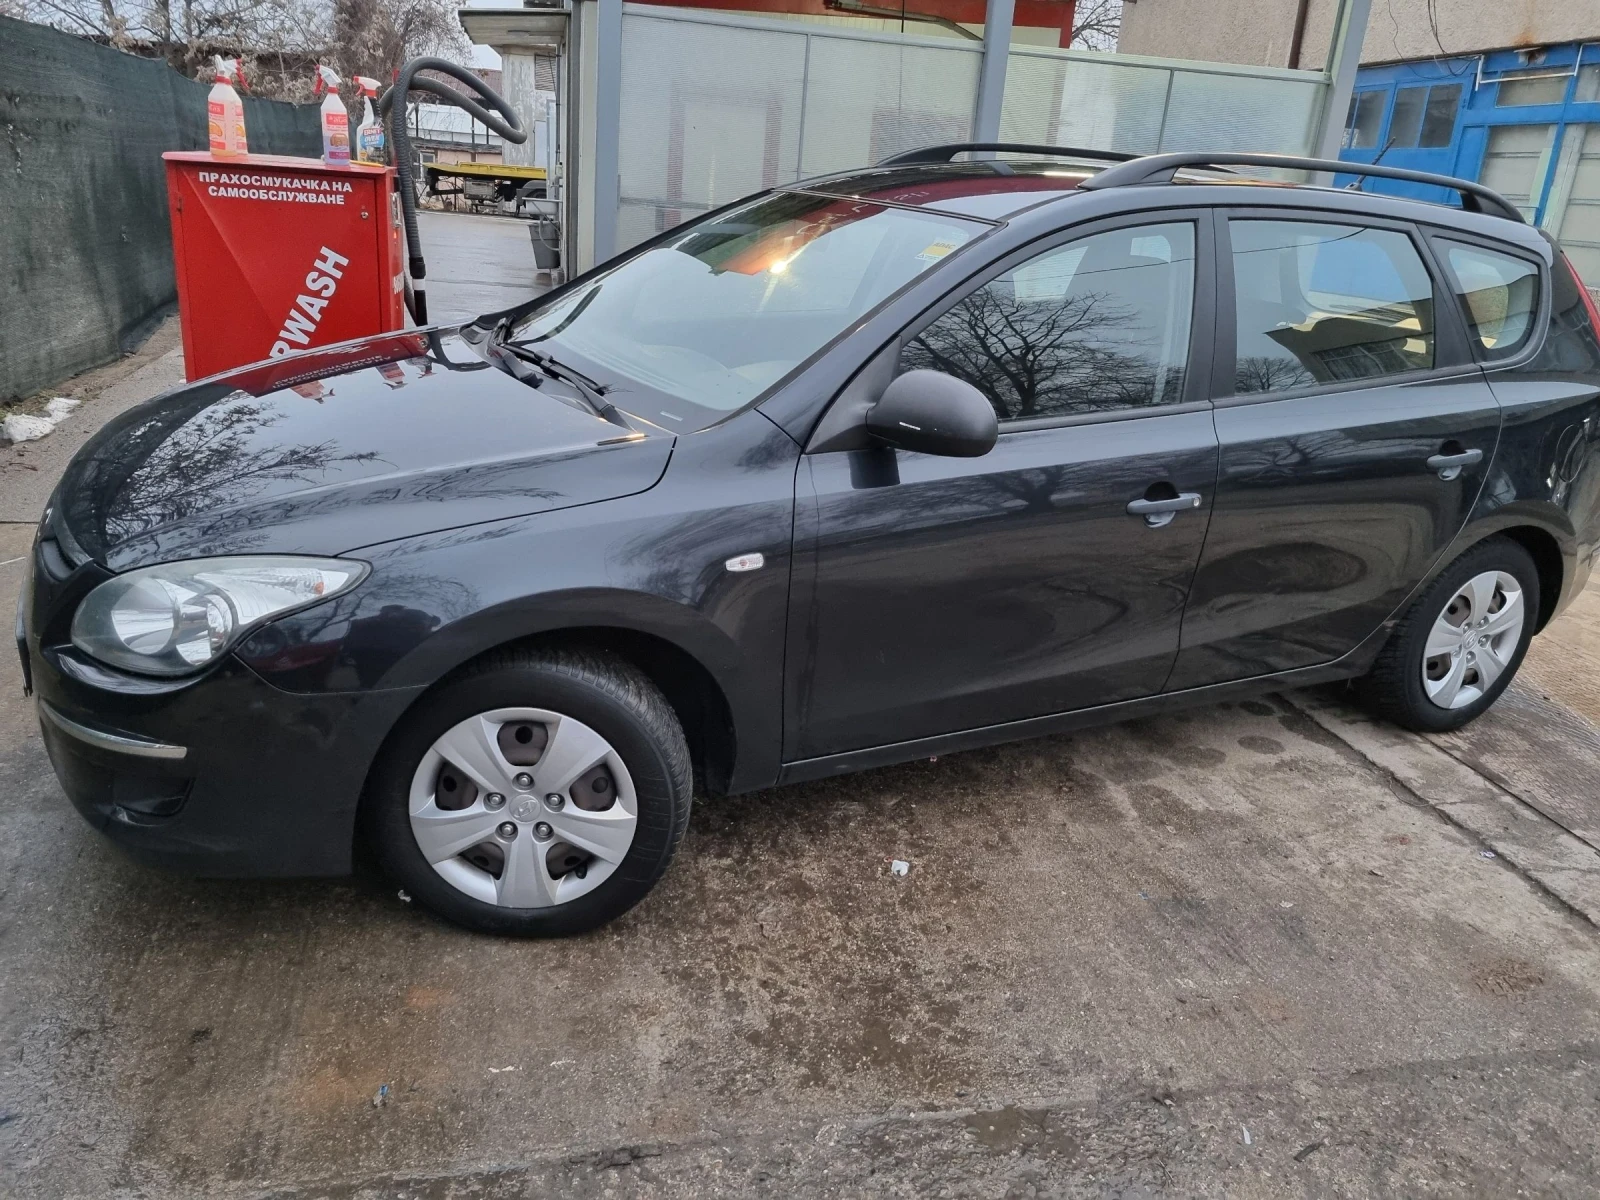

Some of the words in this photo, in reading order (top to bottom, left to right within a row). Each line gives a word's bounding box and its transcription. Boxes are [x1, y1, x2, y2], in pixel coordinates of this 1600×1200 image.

[199, 172, 329, 190] ПРАХОСМУКАЧКА
[332, 181, 353, 192] НА
[208, 186, 345, 204] САМООБСЛУЖВАНЕ
